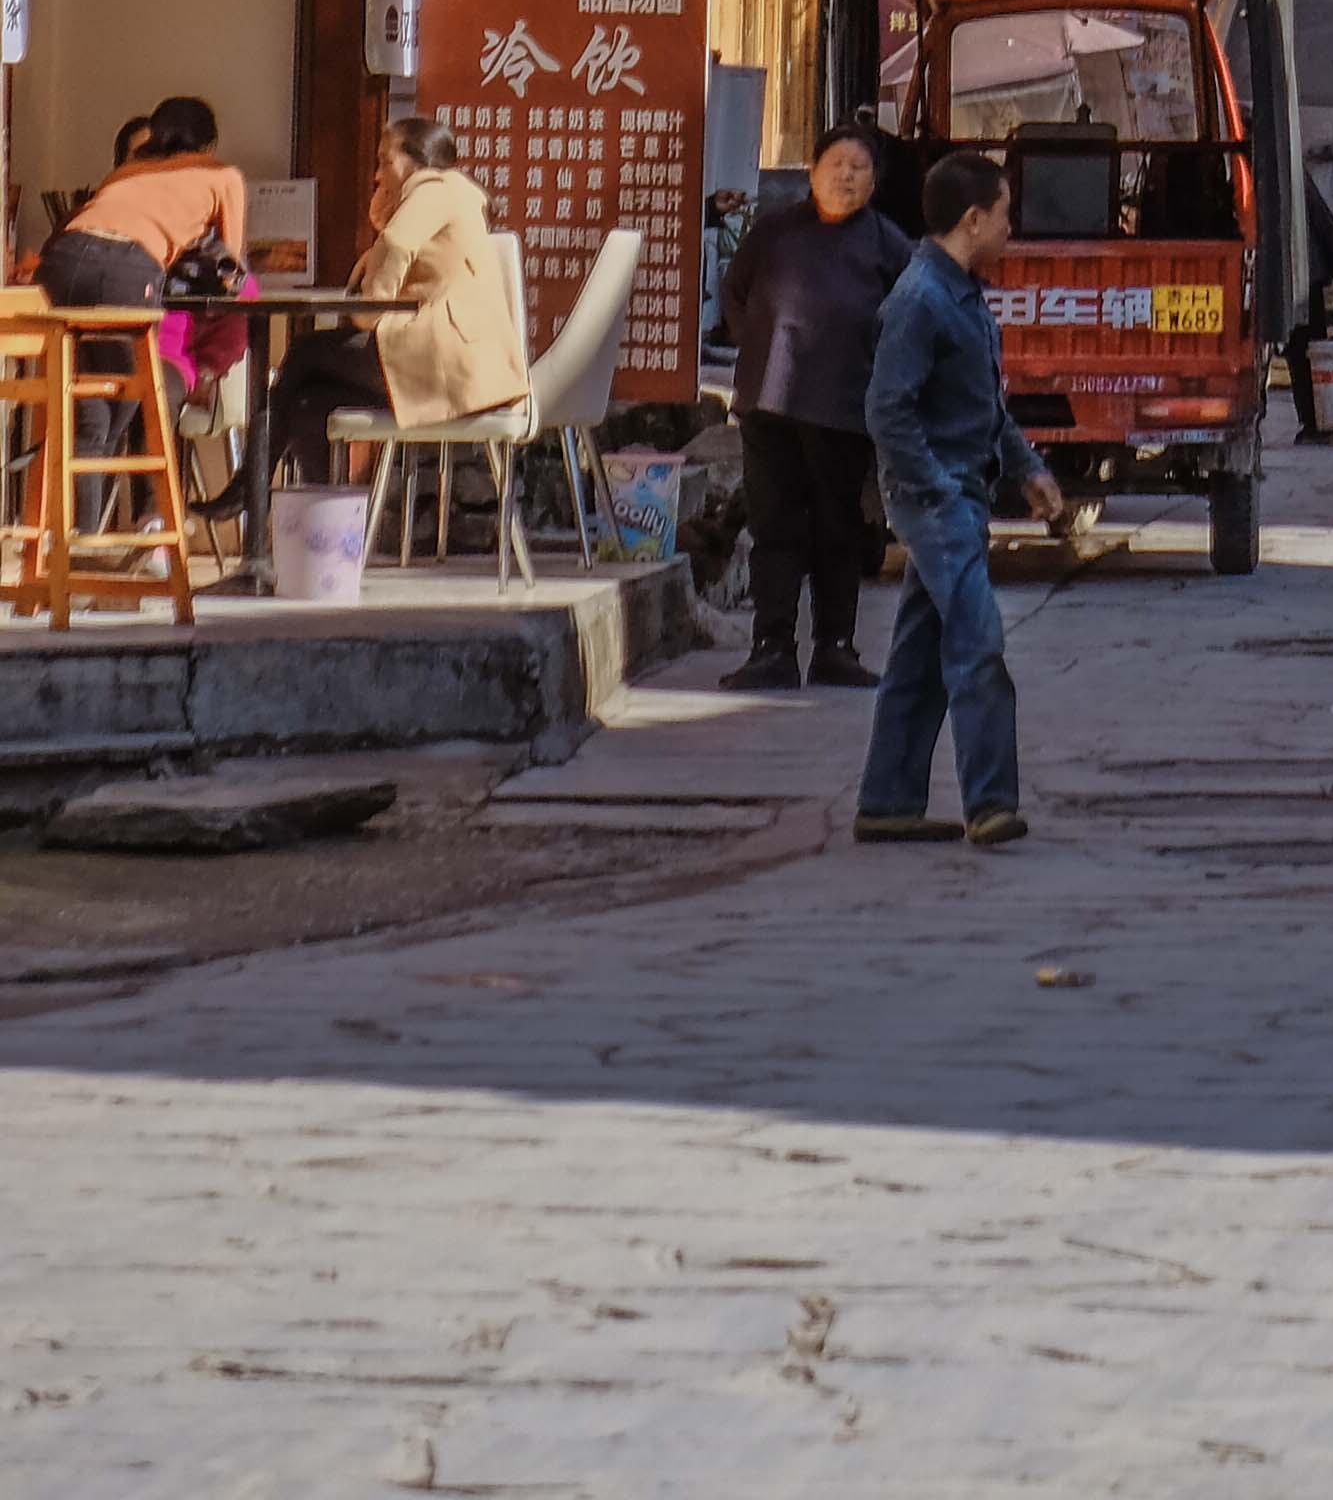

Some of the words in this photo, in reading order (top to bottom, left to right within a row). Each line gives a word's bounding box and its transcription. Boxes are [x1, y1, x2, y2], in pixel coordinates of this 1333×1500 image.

[479, 19, 647, 100] 冷饮
[525, 196, 603, 220] 双皮奶
